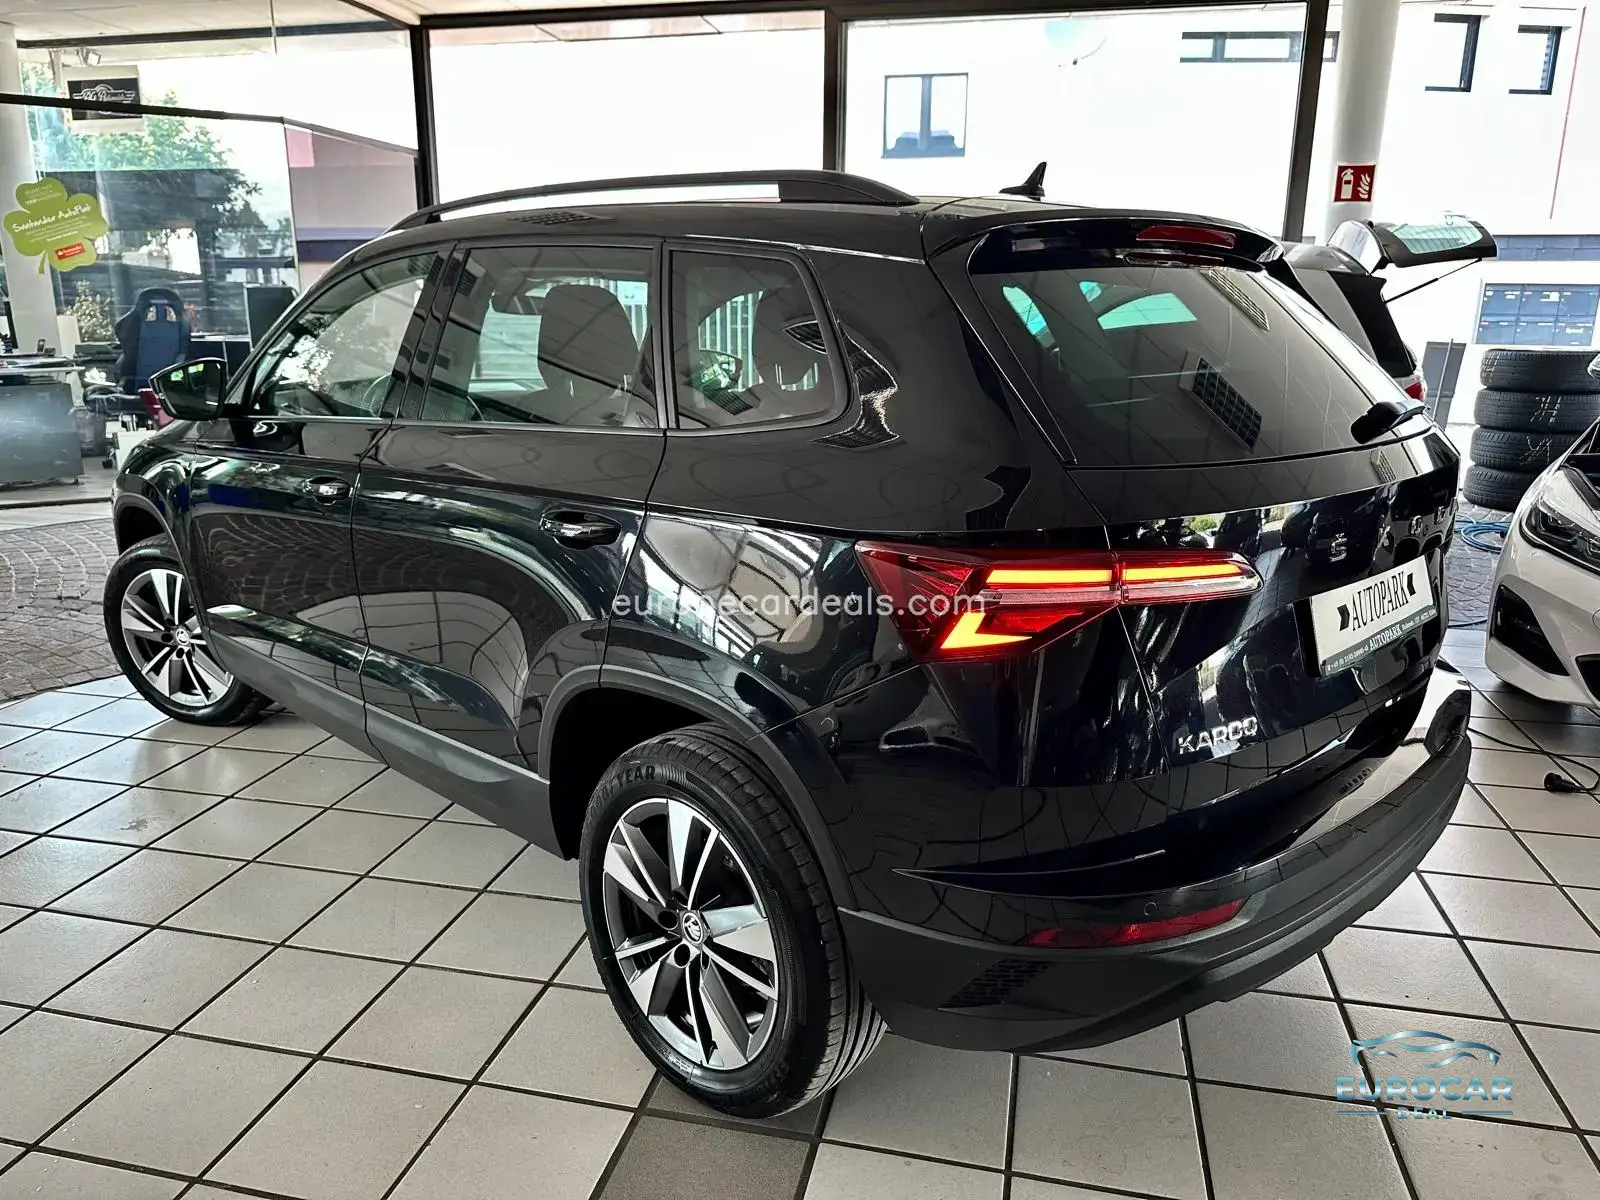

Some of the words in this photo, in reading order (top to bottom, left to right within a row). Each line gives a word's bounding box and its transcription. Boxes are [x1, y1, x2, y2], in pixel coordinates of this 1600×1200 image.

[1351, 571, 1409, 631] AUTOPARK
[1369, 623, 1402, 651] AUTOPARK
[1178, 716, 1258, 755] KAROQ
